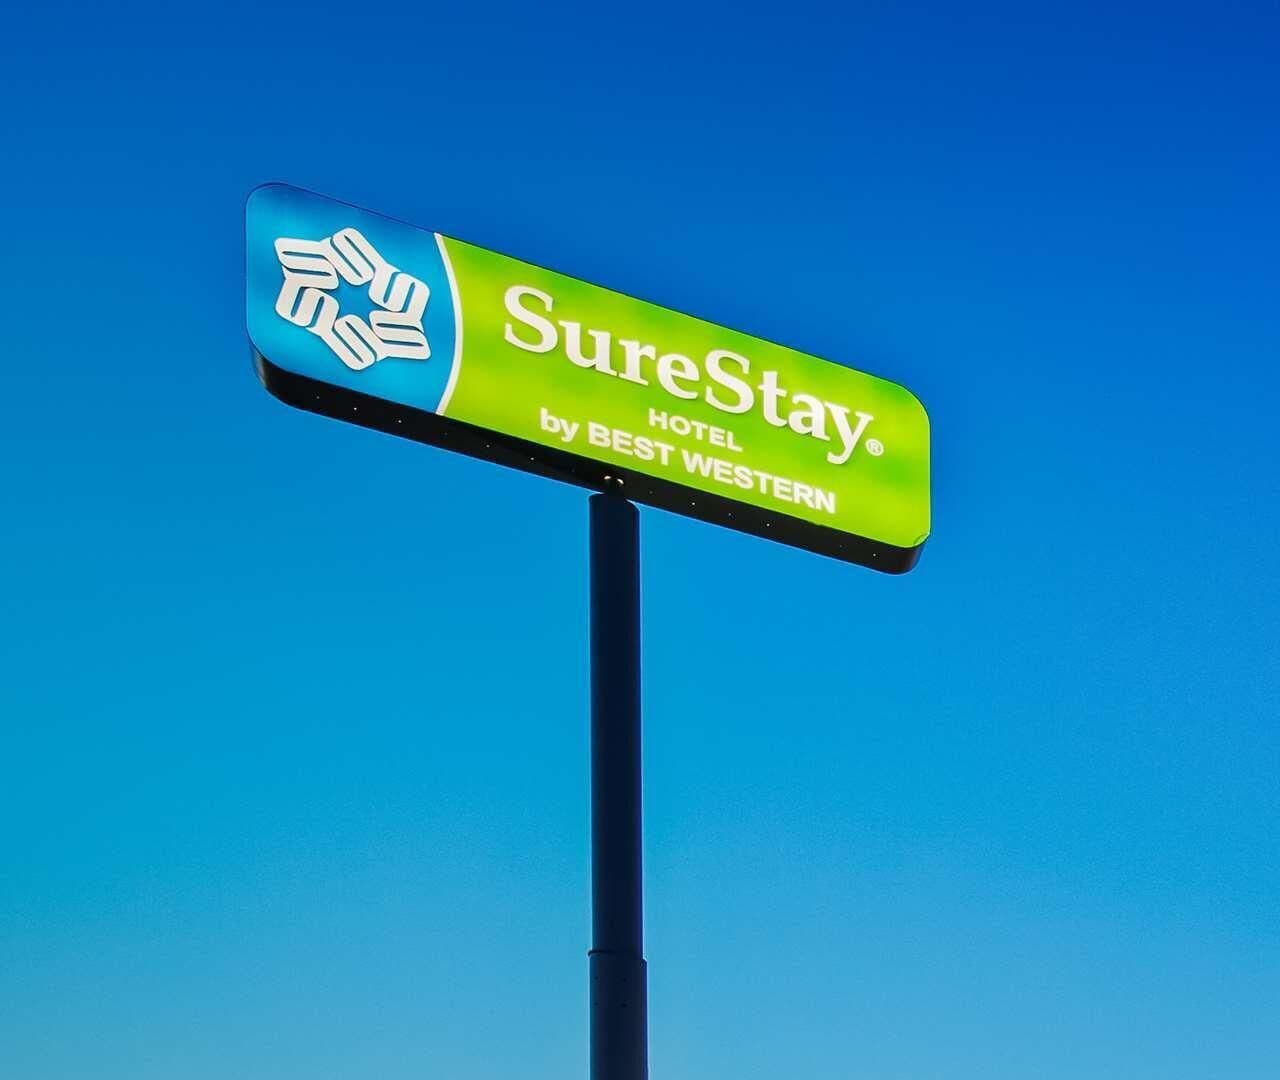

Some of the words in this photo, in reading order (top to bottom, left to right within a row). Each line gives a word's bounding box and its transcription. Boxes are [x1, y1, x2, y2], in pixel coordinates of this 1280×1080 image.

[539, 407, 580, 443] by
[587, 421, 675, 466] BEST
[681, 448, 837, 515] WESTERN
[649, 407, 744, 453] HOTEL
